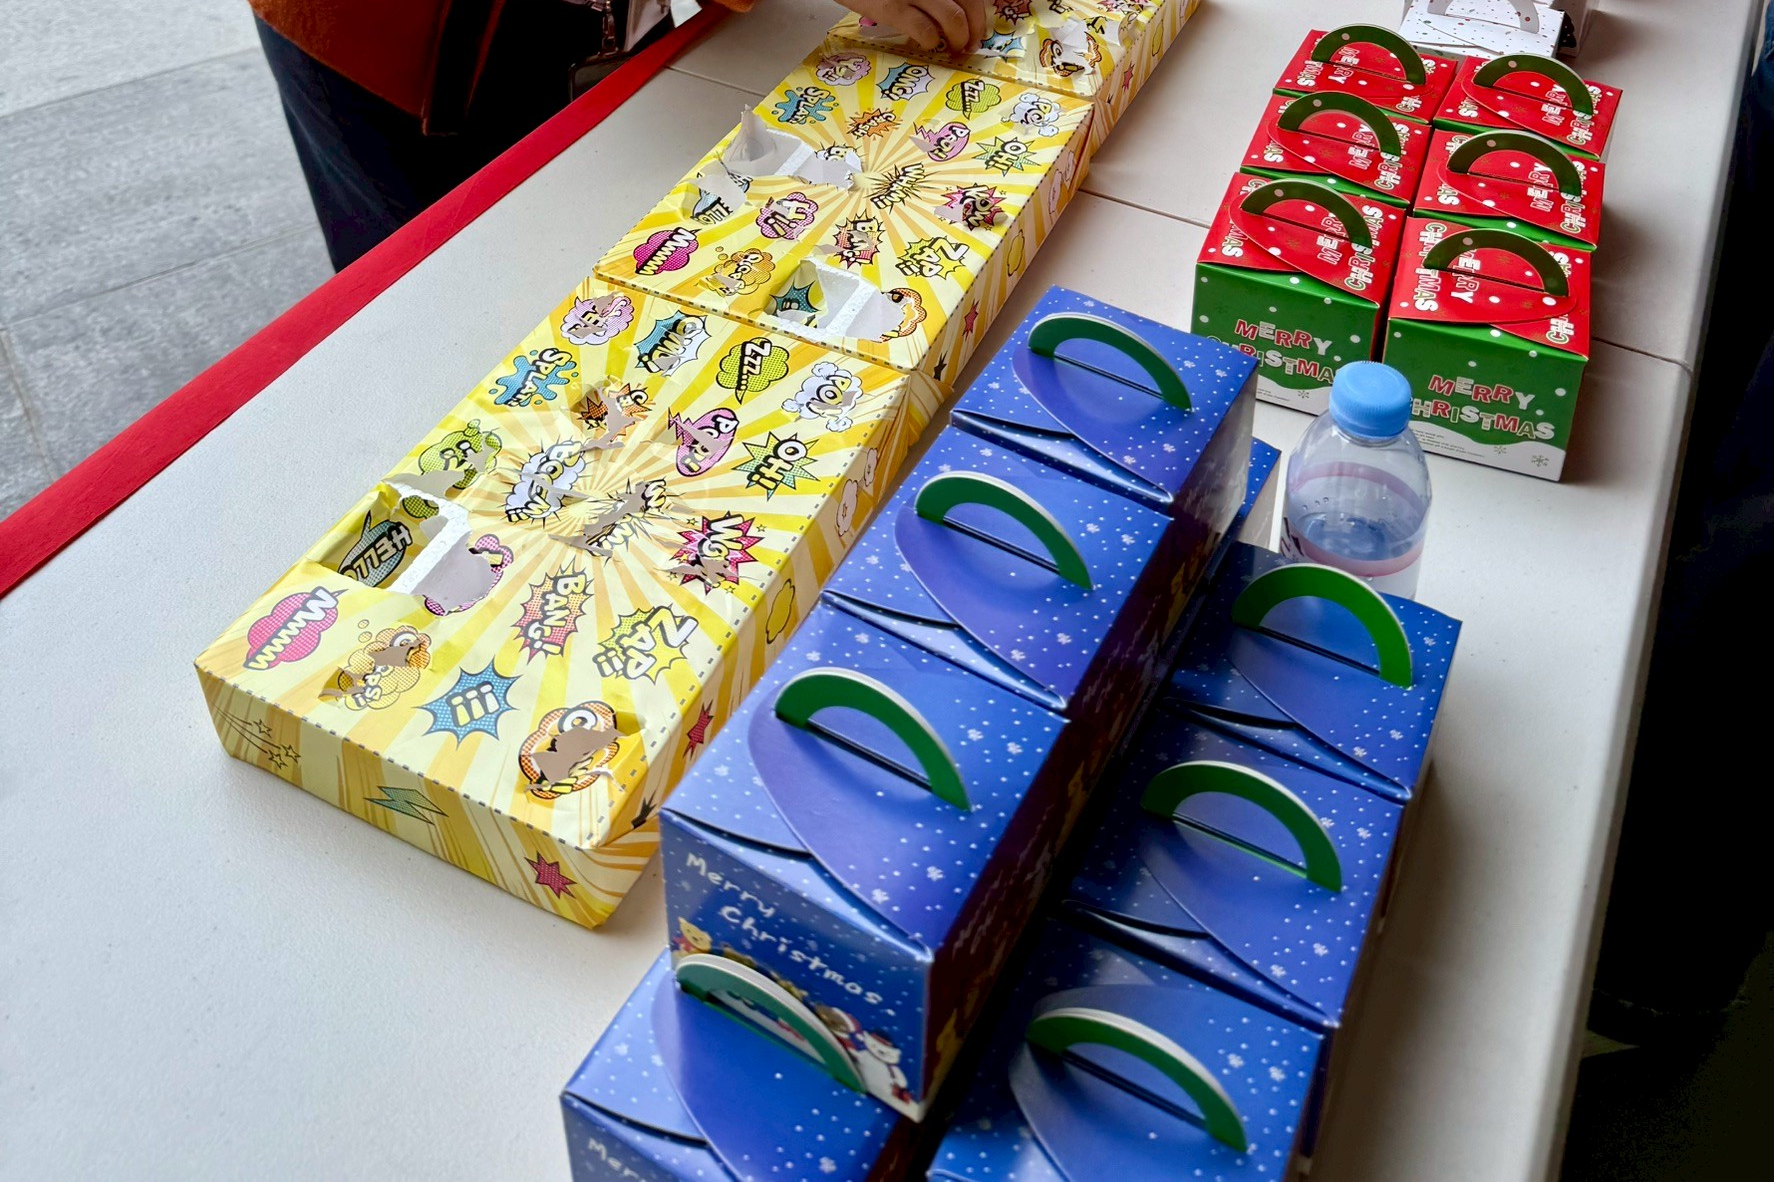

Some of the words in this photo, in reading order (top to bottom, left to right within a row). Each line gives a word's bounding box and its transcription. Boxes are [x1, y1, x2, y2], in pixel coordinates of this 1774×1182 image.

[982, 141, 1028, 172] OH!
[1234, 319, 1332, 356] MERRY
[1411, 397, 1555, 440] HRISTMAS
[1428, 374, 1535, 410] MERRY
[745, 438, 811, 492] OH!
[529, 574, 586, 657] BANG!
[591, 605, 699, 682] ZAP!!
[686, 852, 777, 918] Merry
[720, 905, 883, 1006] Christmas
